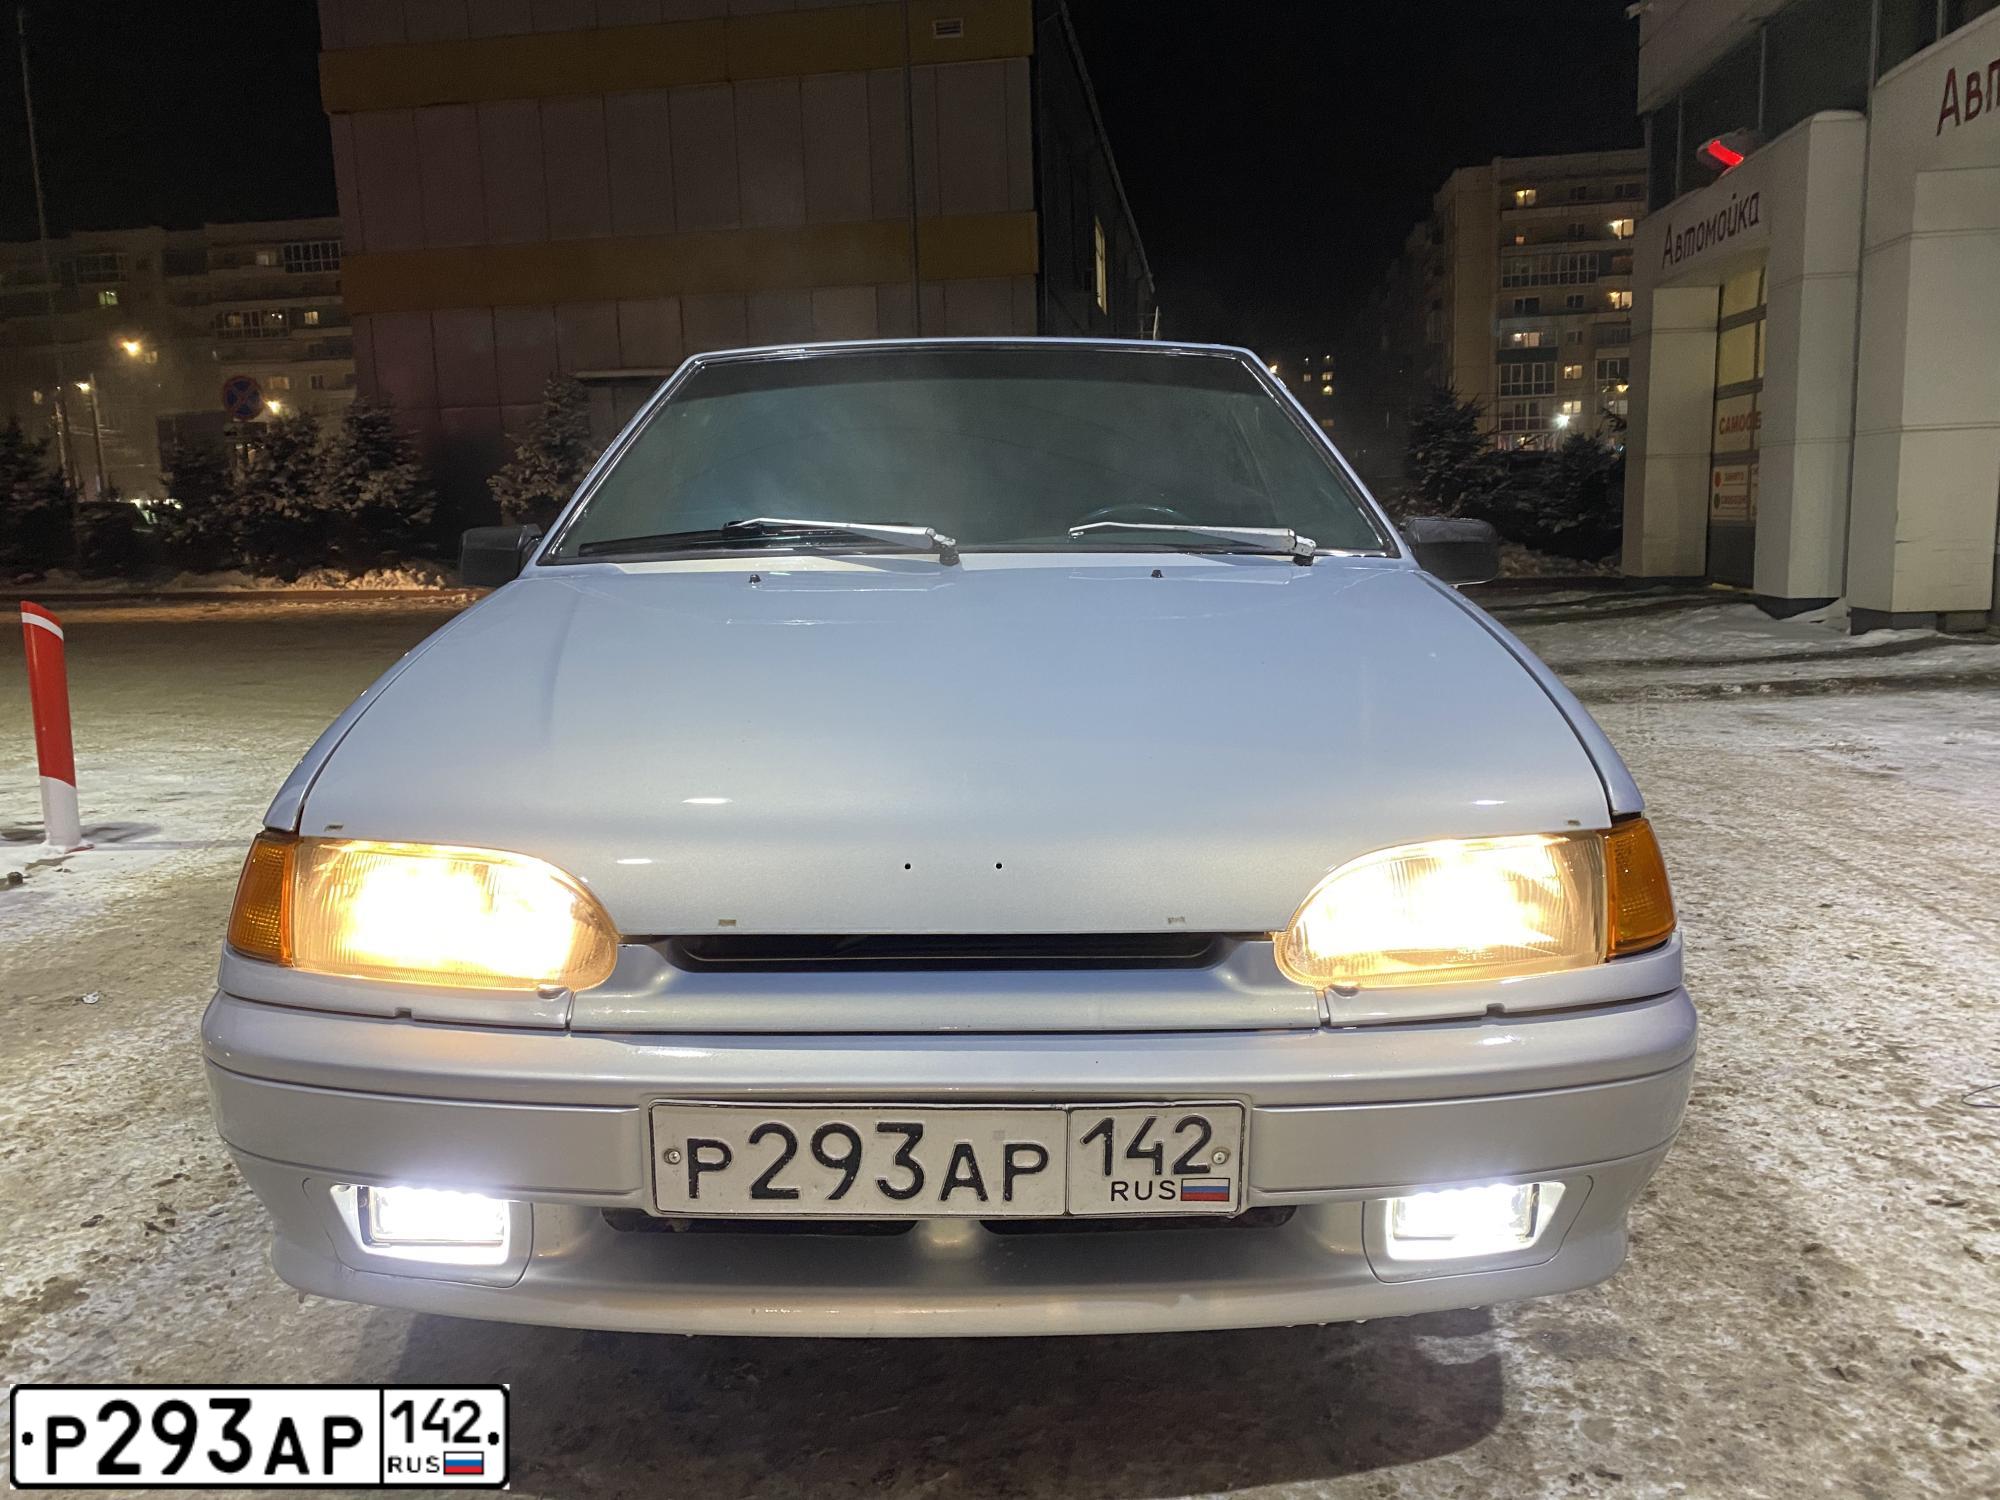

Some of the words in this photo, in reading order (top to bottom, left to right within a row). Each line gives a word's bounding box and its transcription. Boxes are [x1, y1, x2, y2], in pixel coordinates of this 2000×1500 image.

[1662, 192, 1760, 270] Автомойка
[687, 1121, 1049, 1202] Р293АР
[1080, 1115, 1212, 1176] 142
[1110, 1180, 1176, 1202] RUS
